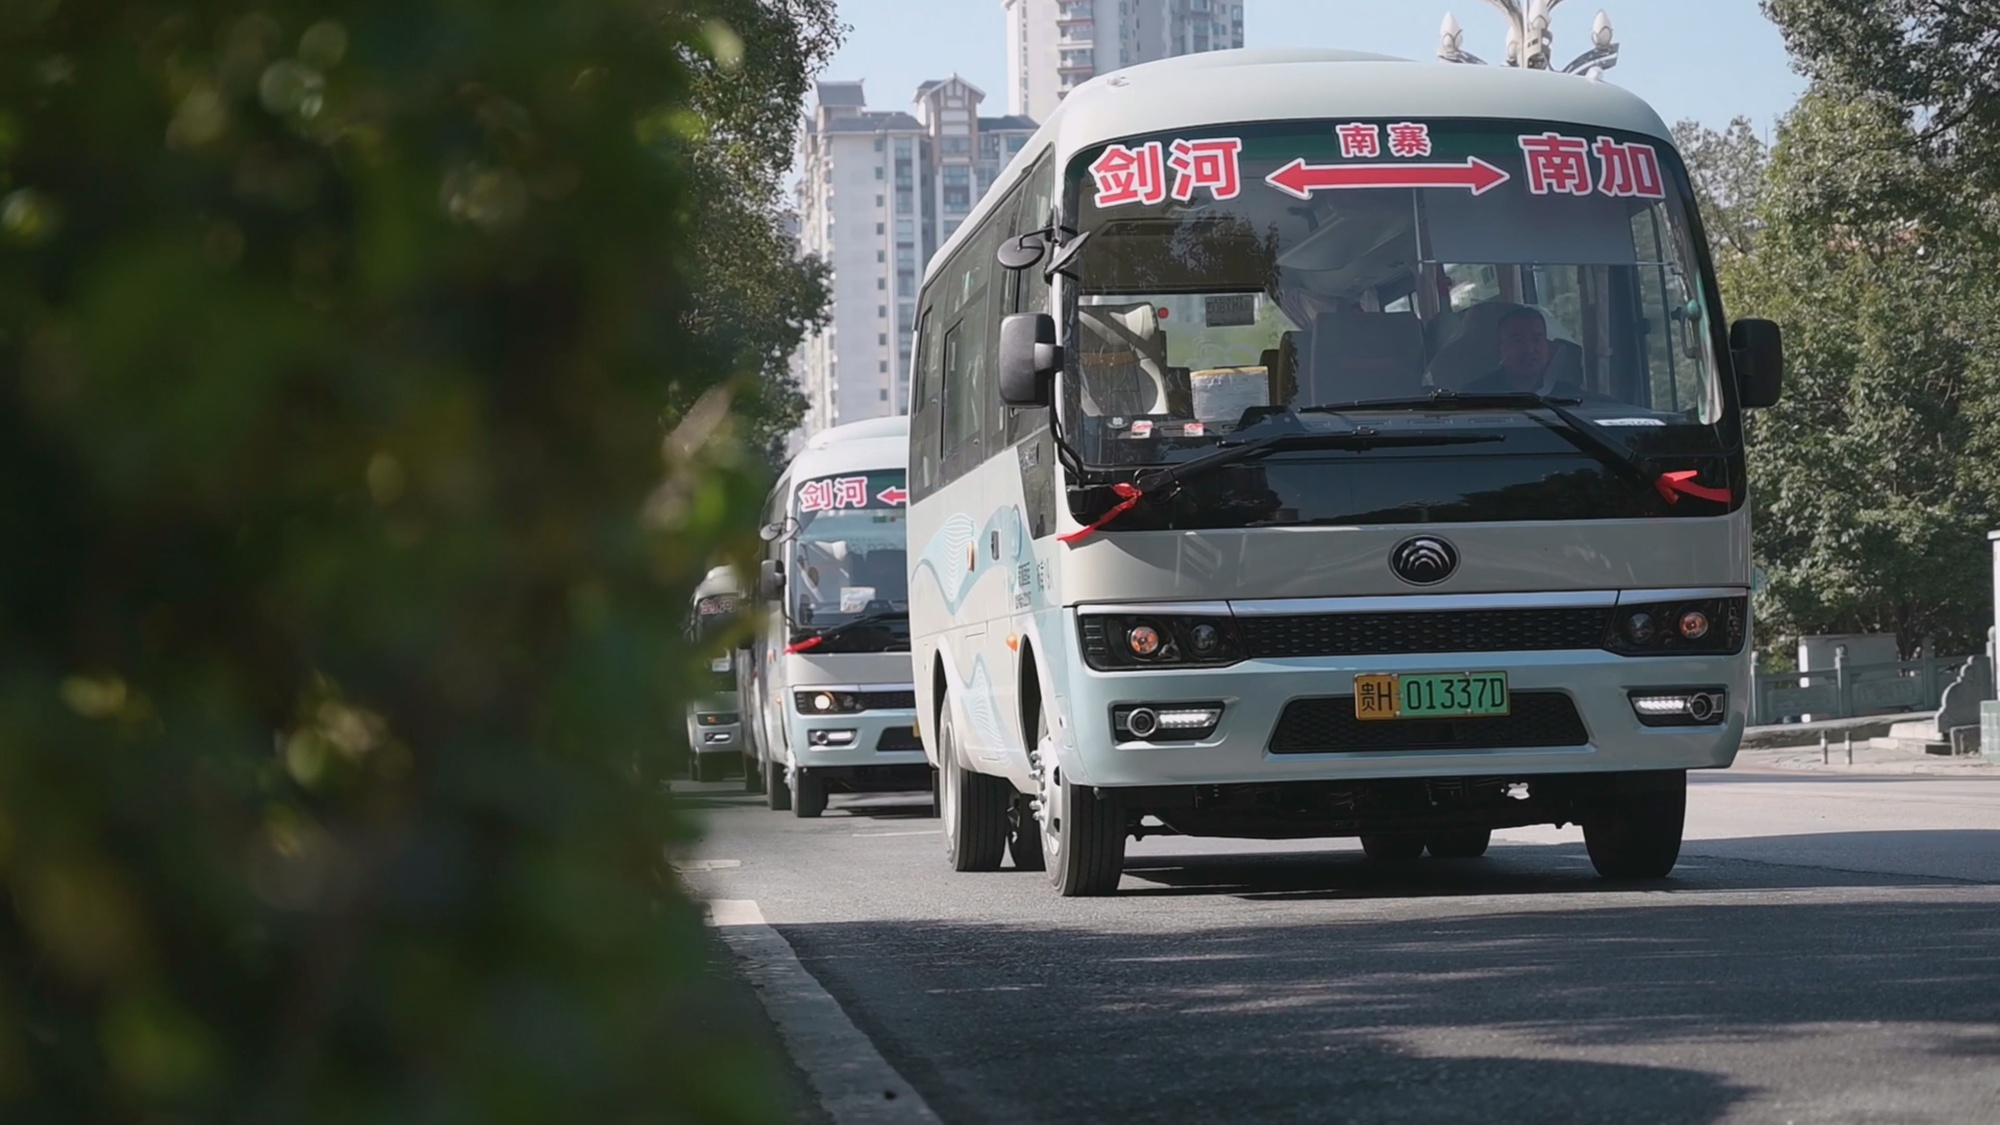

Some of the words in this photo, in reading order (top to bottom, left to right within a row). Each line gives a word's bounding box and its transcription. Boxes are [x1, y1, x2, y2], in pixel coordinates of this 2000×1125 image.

[1338, 123, 1431, 155] 南寨
[1090, 138, 1240, 206] 剑河
[1519, 133, 1664, 196] 南加
[799, 477, 867, 511] 剑河
